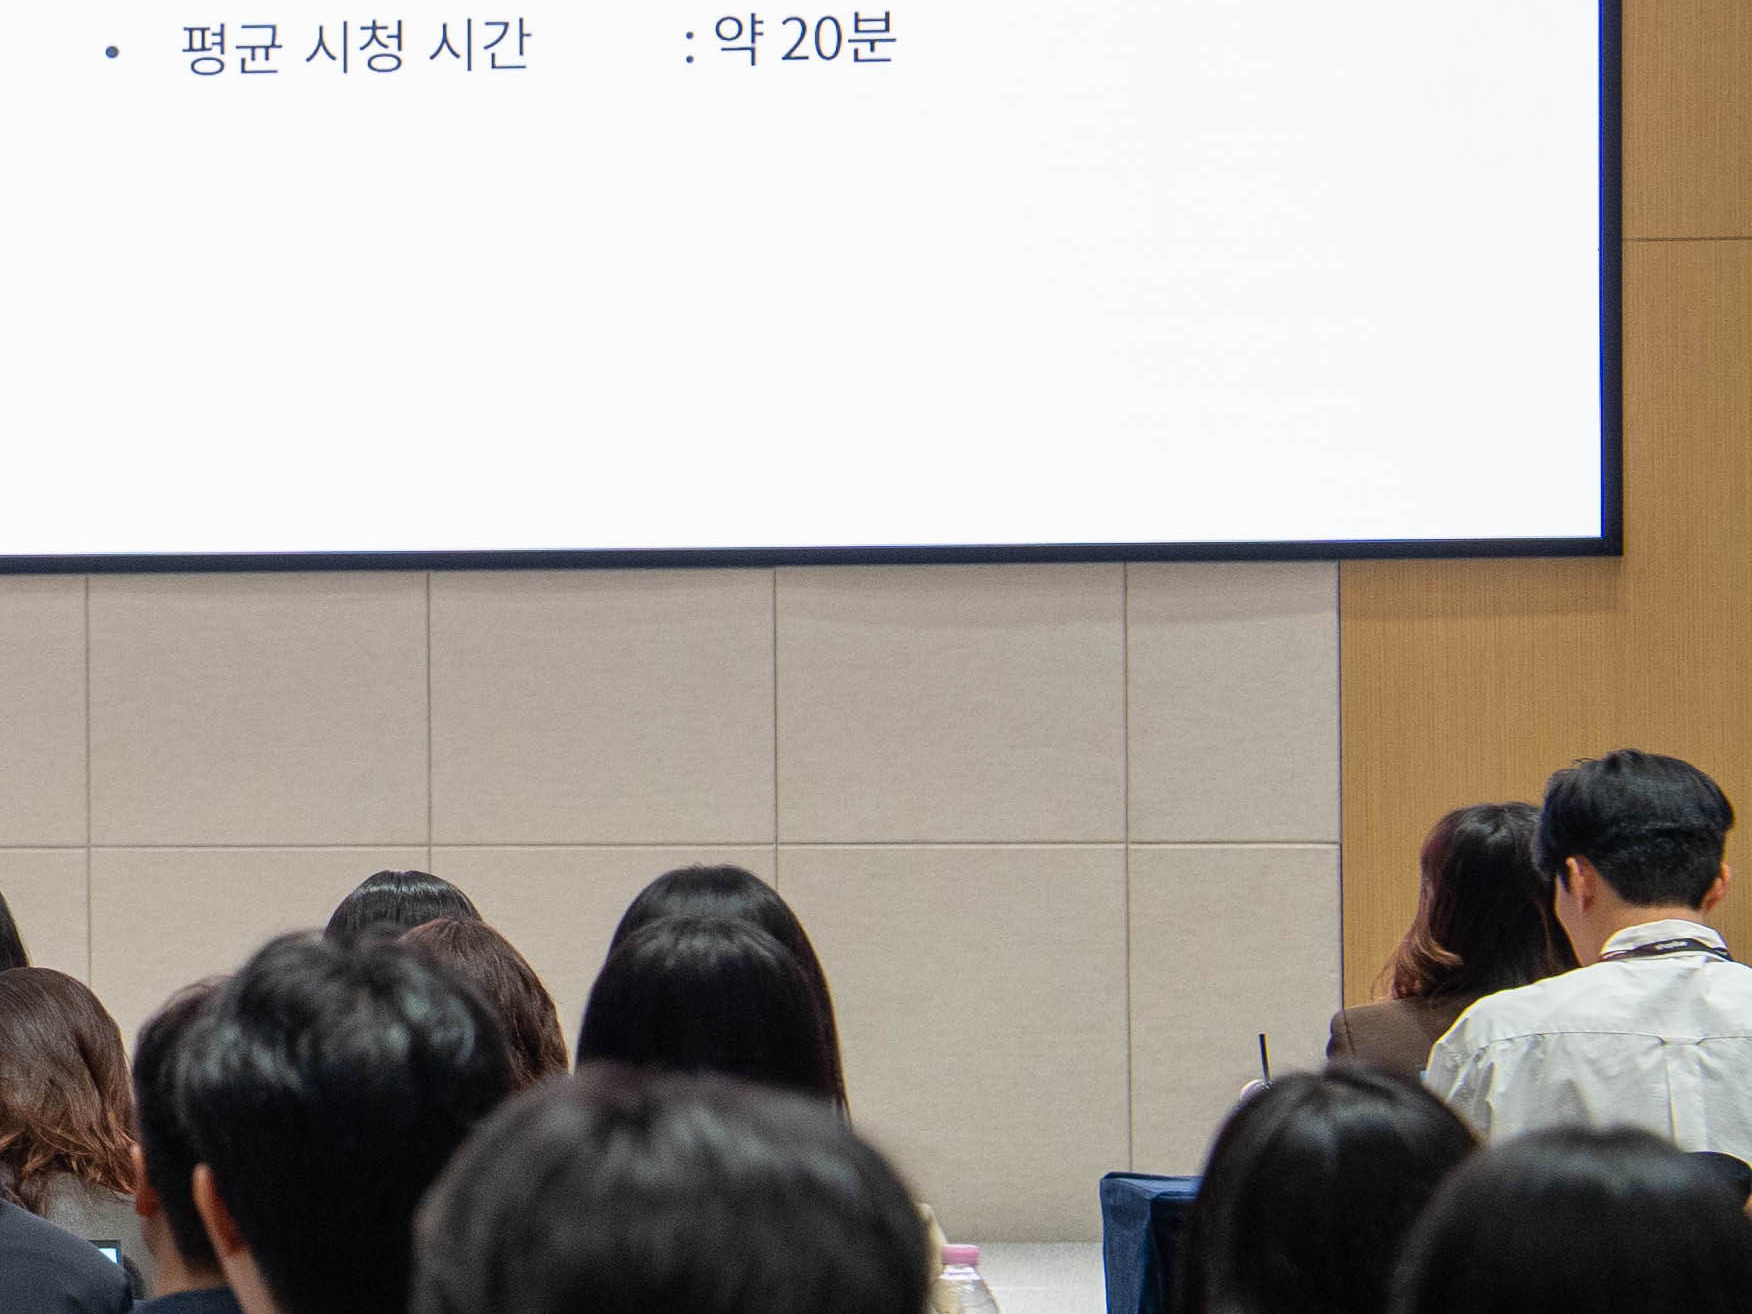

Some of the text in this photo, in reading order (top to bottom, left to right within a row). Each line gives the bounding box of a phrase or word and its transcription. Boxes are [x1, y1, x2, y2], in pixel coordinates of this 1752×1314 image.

[182, 23, 282, 76] 평균
[306, 19, 402, 73] 시청
[429, 17, 531, 71] 시간
[715, 13, 764, 66] 약
[781, 11, 896, 63] 20분
